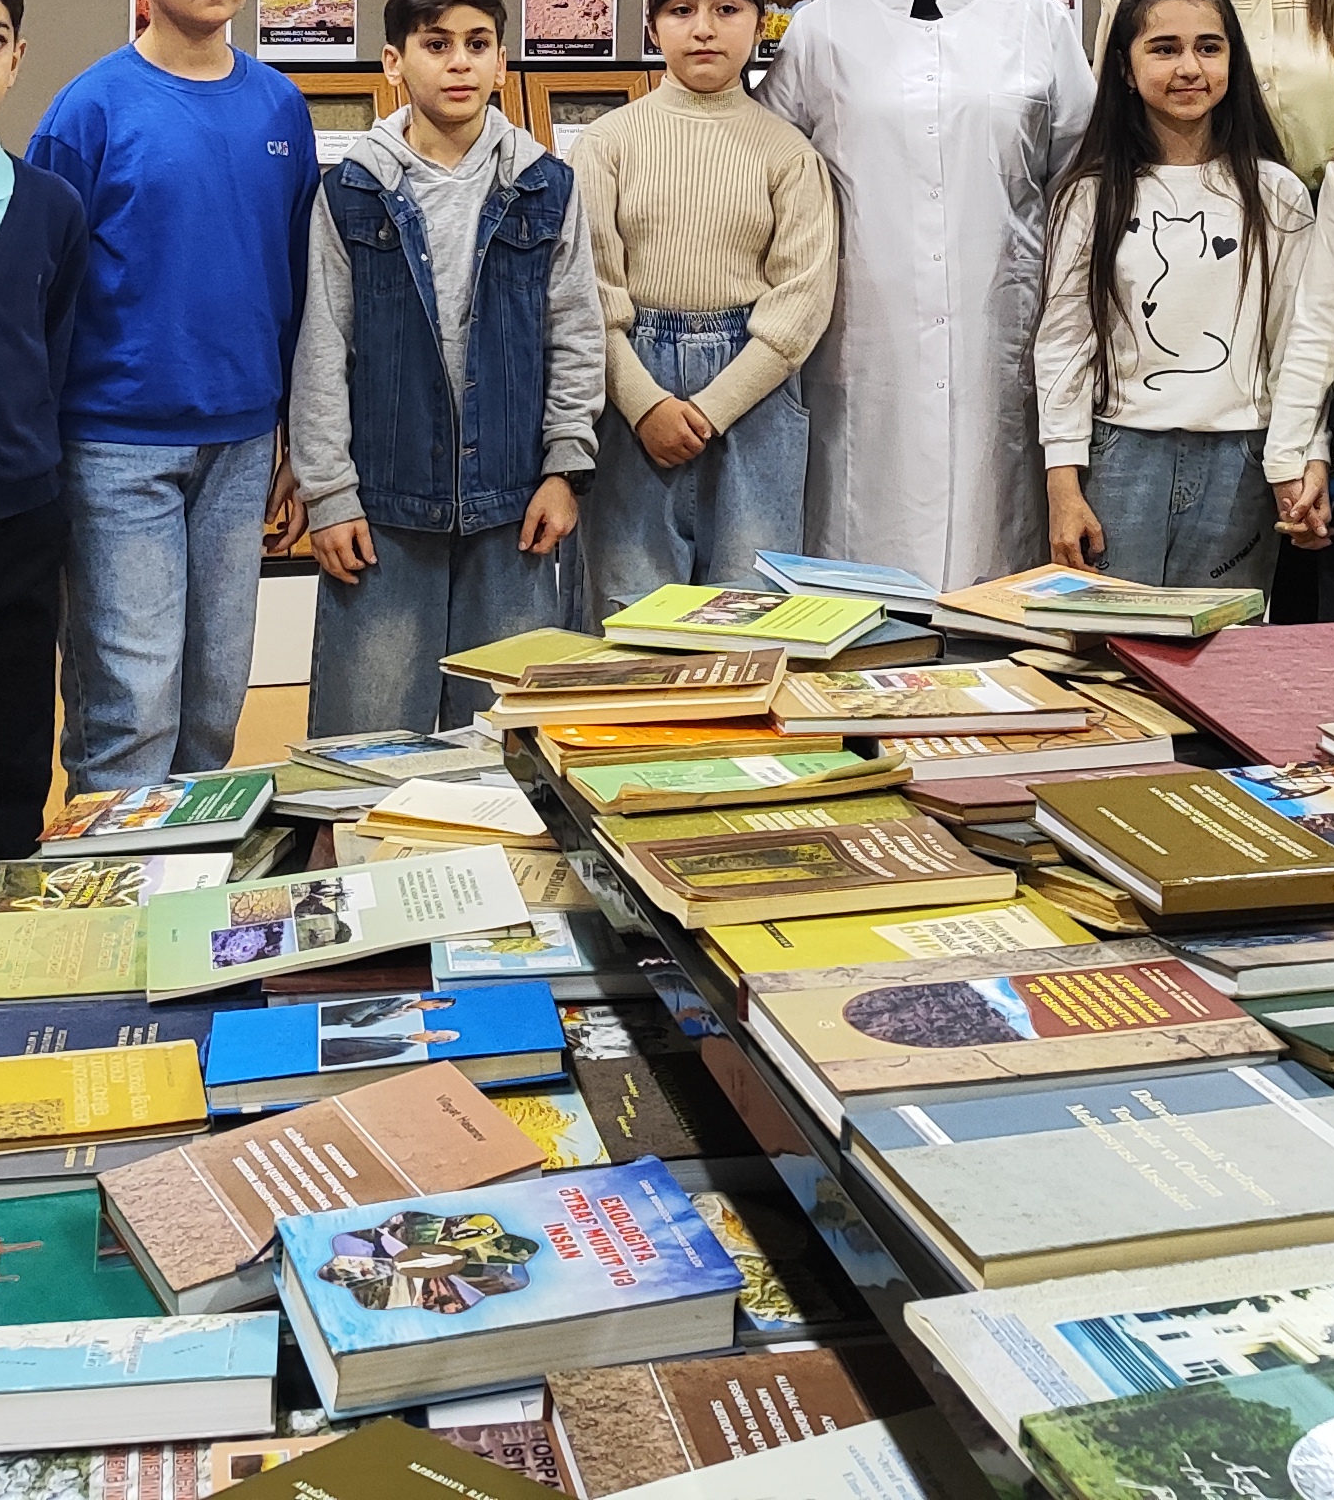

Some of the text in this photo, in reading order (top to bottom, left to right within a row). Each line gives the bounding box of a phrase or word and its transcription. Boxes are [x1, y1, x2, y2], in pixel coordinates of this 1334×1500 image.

[1107, 972, 1175, 1019] AZƏRBAYCAN
[540, 1219, 593, 1261] İNSAN
[554, 1185, 640, 1288] ƏTRAF MÜHİT VƏ
[593, 1194, 670, 1266] EKOLOGİYA,
[740, 1416, 760, 1431] VƏ
[753, 1386, 793, 1445] MORFOGENETİ
[772, 1372, 818, 1438] ALLÜVİAL-HİDRO
[529, 1437, 561, 1488] TORPA
